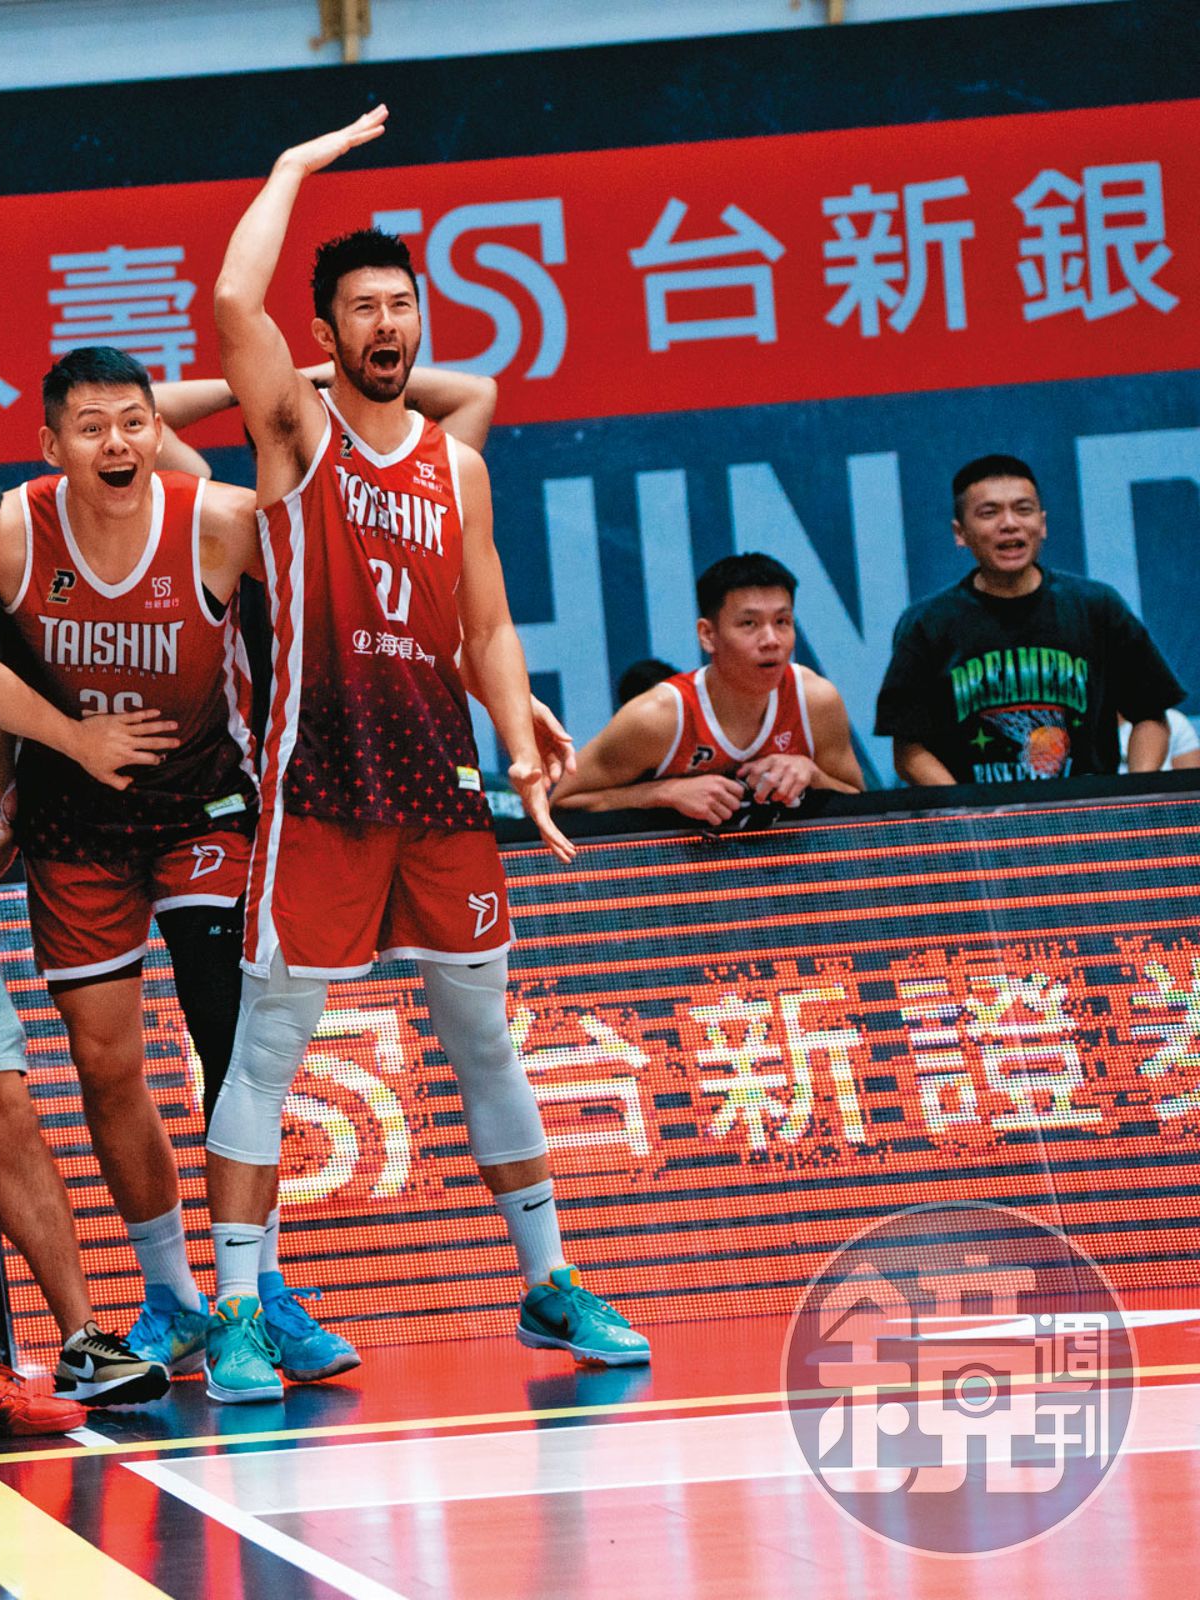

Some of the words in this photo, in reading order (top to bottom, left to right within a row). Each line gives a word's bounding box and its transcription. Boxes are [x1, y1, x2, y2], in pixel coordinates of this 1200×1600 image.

[628, 161, 1181, 353] 台新銀
[334, 464, 449, 557] TAISHIN
[36, 613, 186, 676] TAISHIN
[950, 646, 1089, 723] DREAMERS
